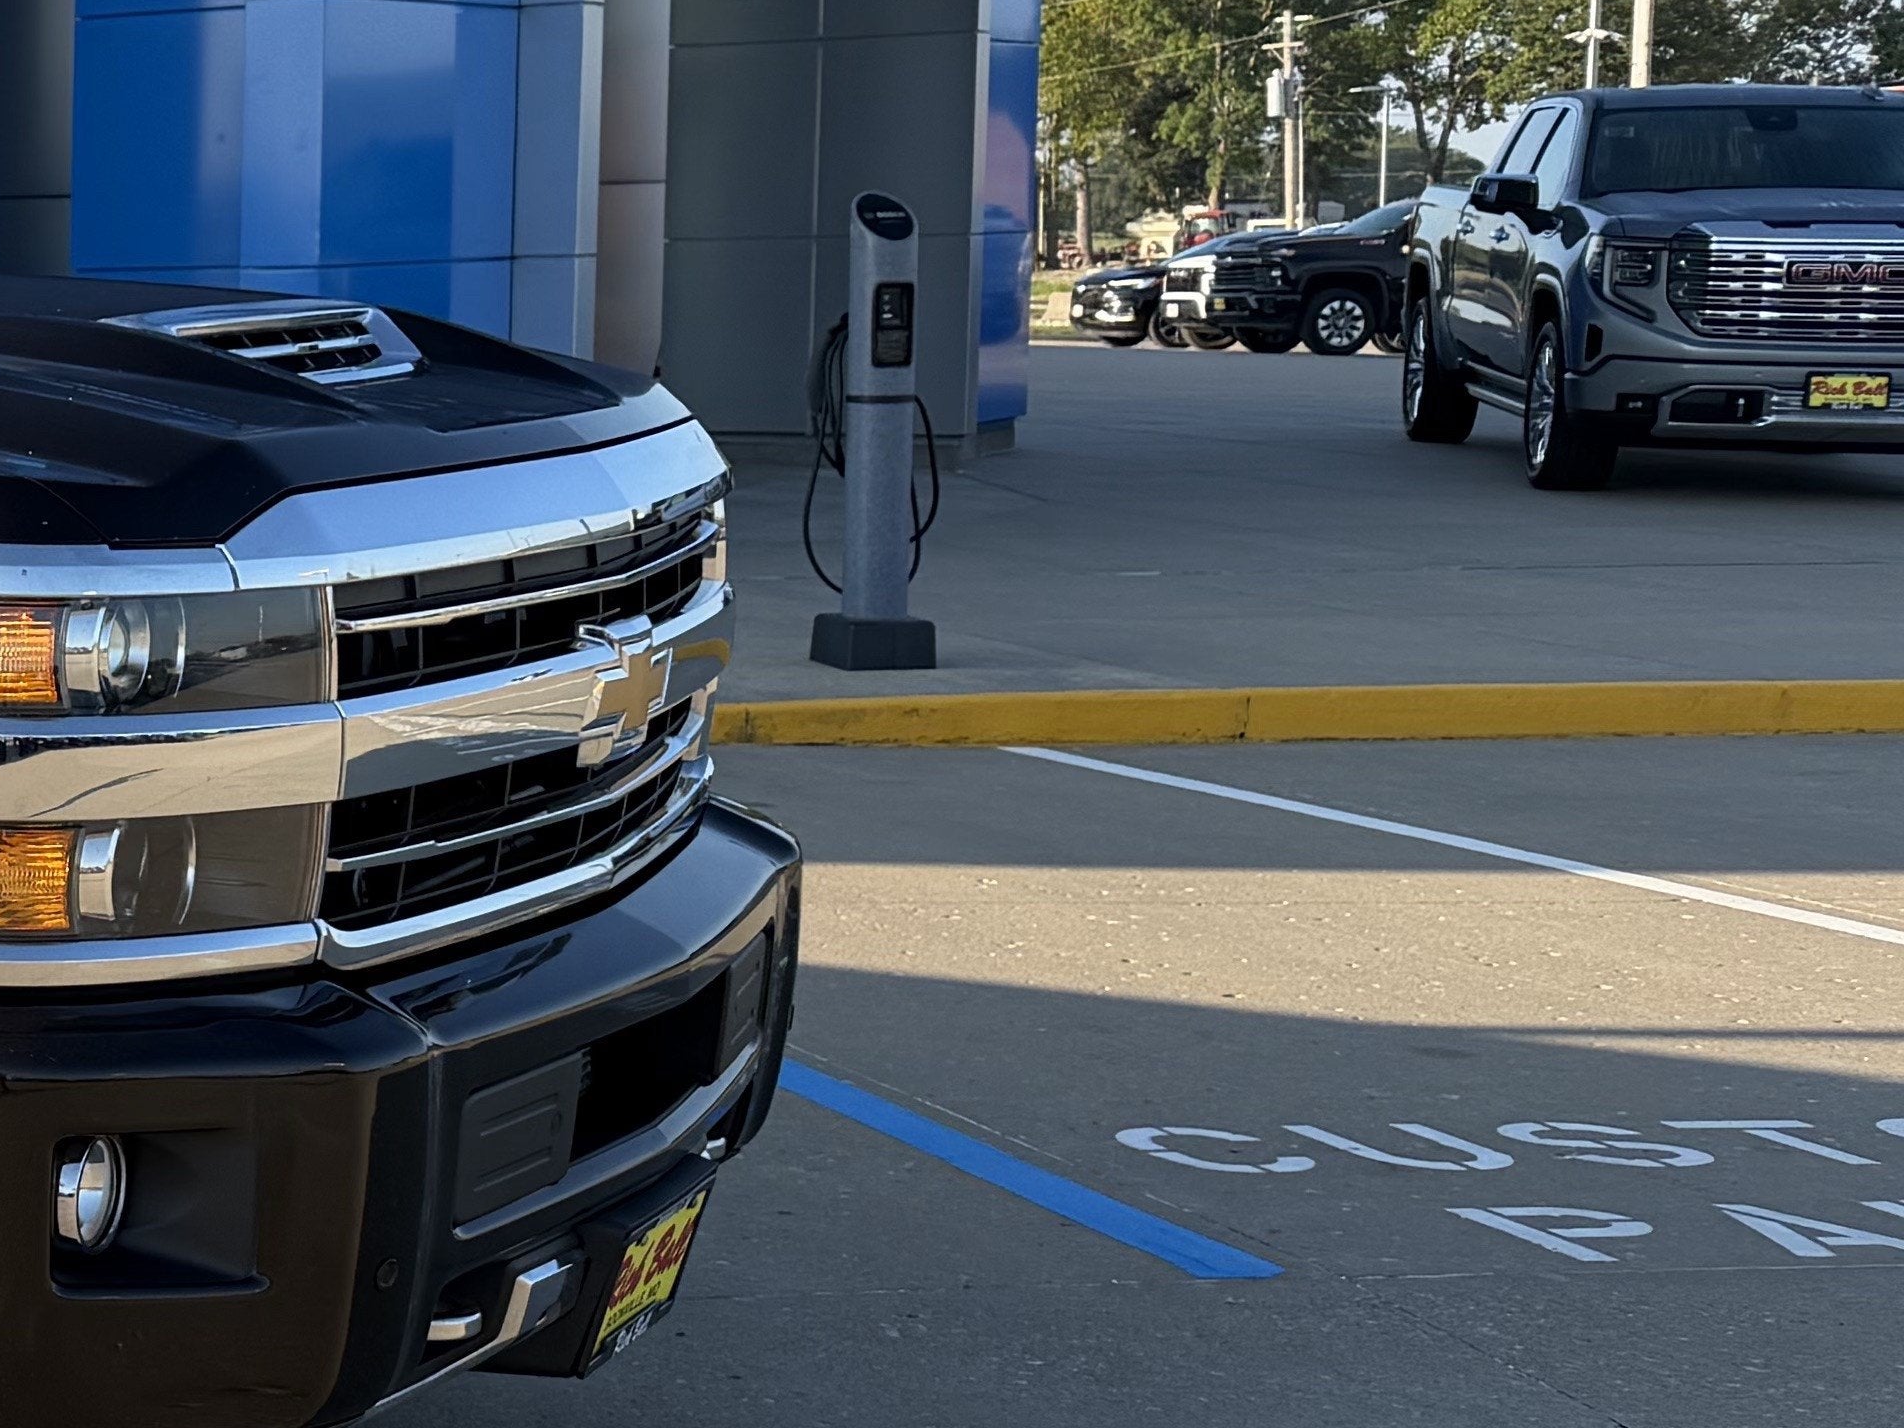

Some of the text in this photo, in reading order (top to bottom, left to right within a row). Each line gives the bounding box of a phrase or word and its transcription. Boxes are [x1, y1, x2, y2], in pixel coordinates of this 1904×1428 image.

[1792, 263, 1904, 283] GMC
[1811, 380, 1848, 396] Rick
[1115, 1119, 1904, 1174] CUST
